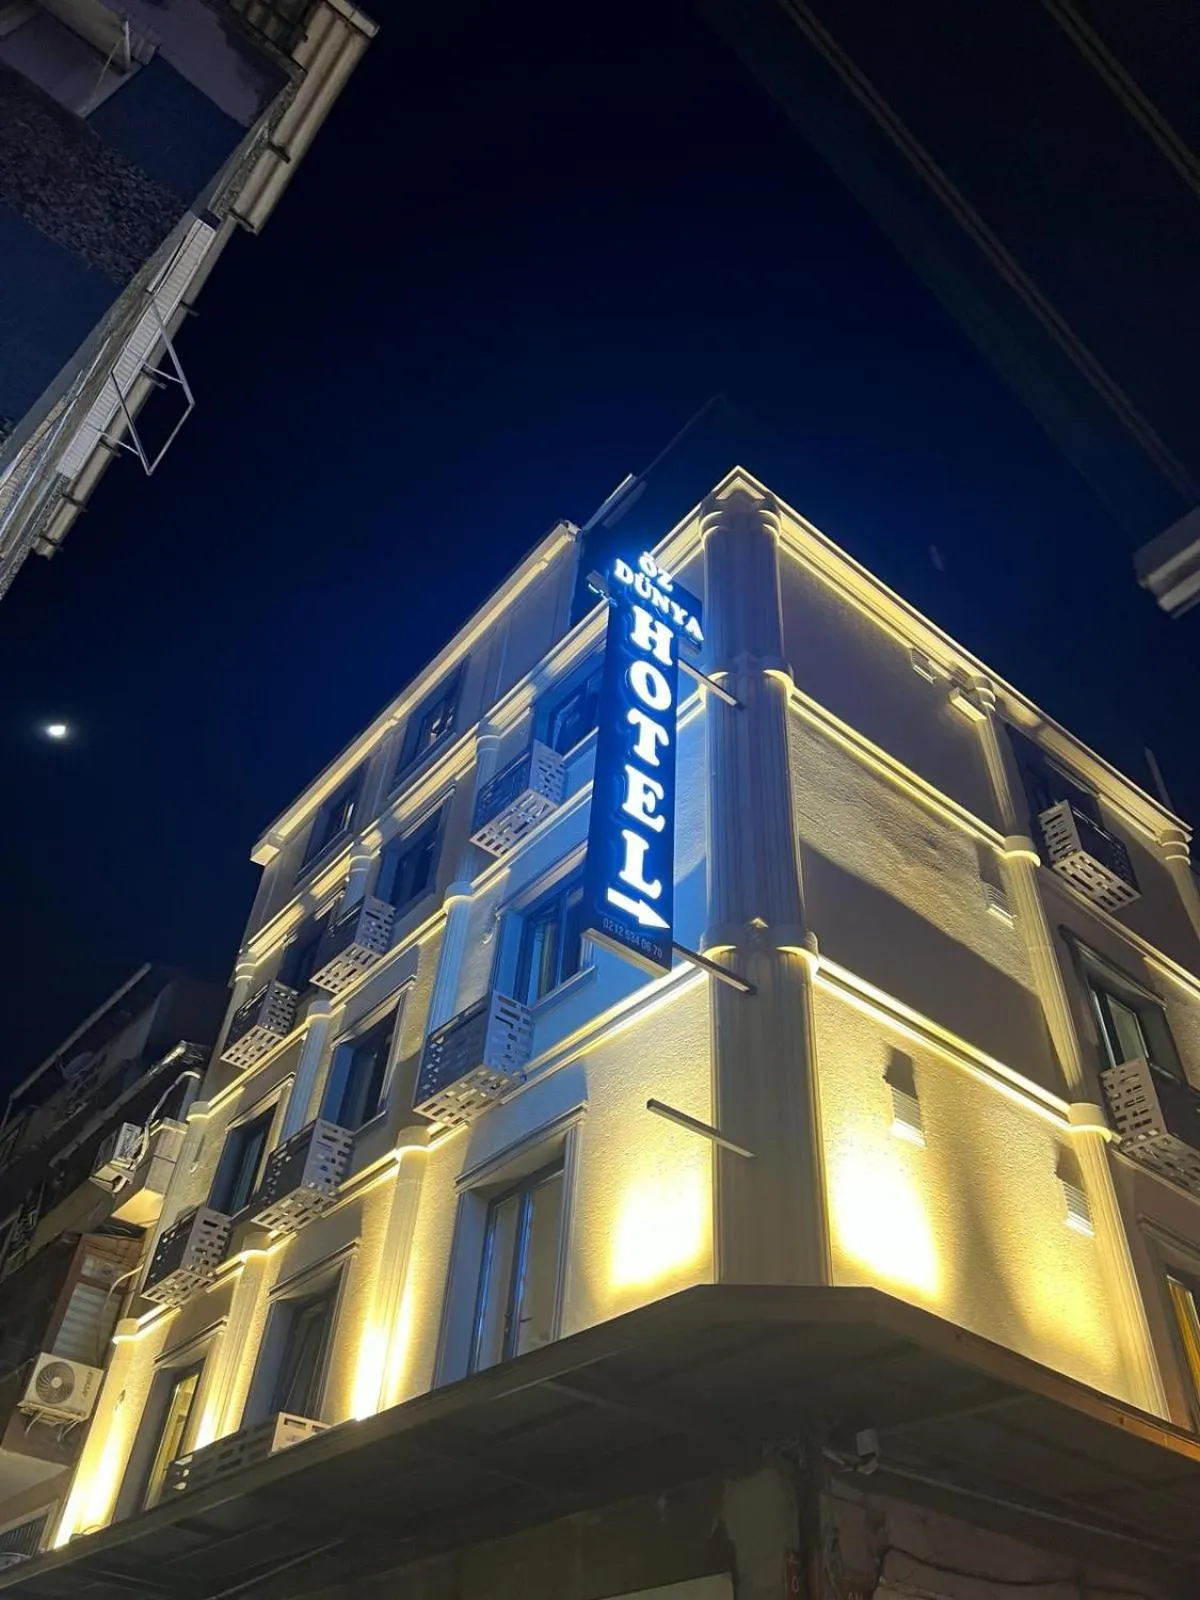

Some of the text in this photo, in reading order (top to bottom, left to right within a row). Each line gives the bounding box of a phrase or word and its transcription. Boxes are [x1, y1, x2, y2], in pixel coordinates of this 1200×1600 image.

[614, 558, 704, 641] DÜNYA
[639, 551, 674, 592] ÖZ
[618, 605, 674, 900] HOTEL
[603, 917, 624, 936] 0212
